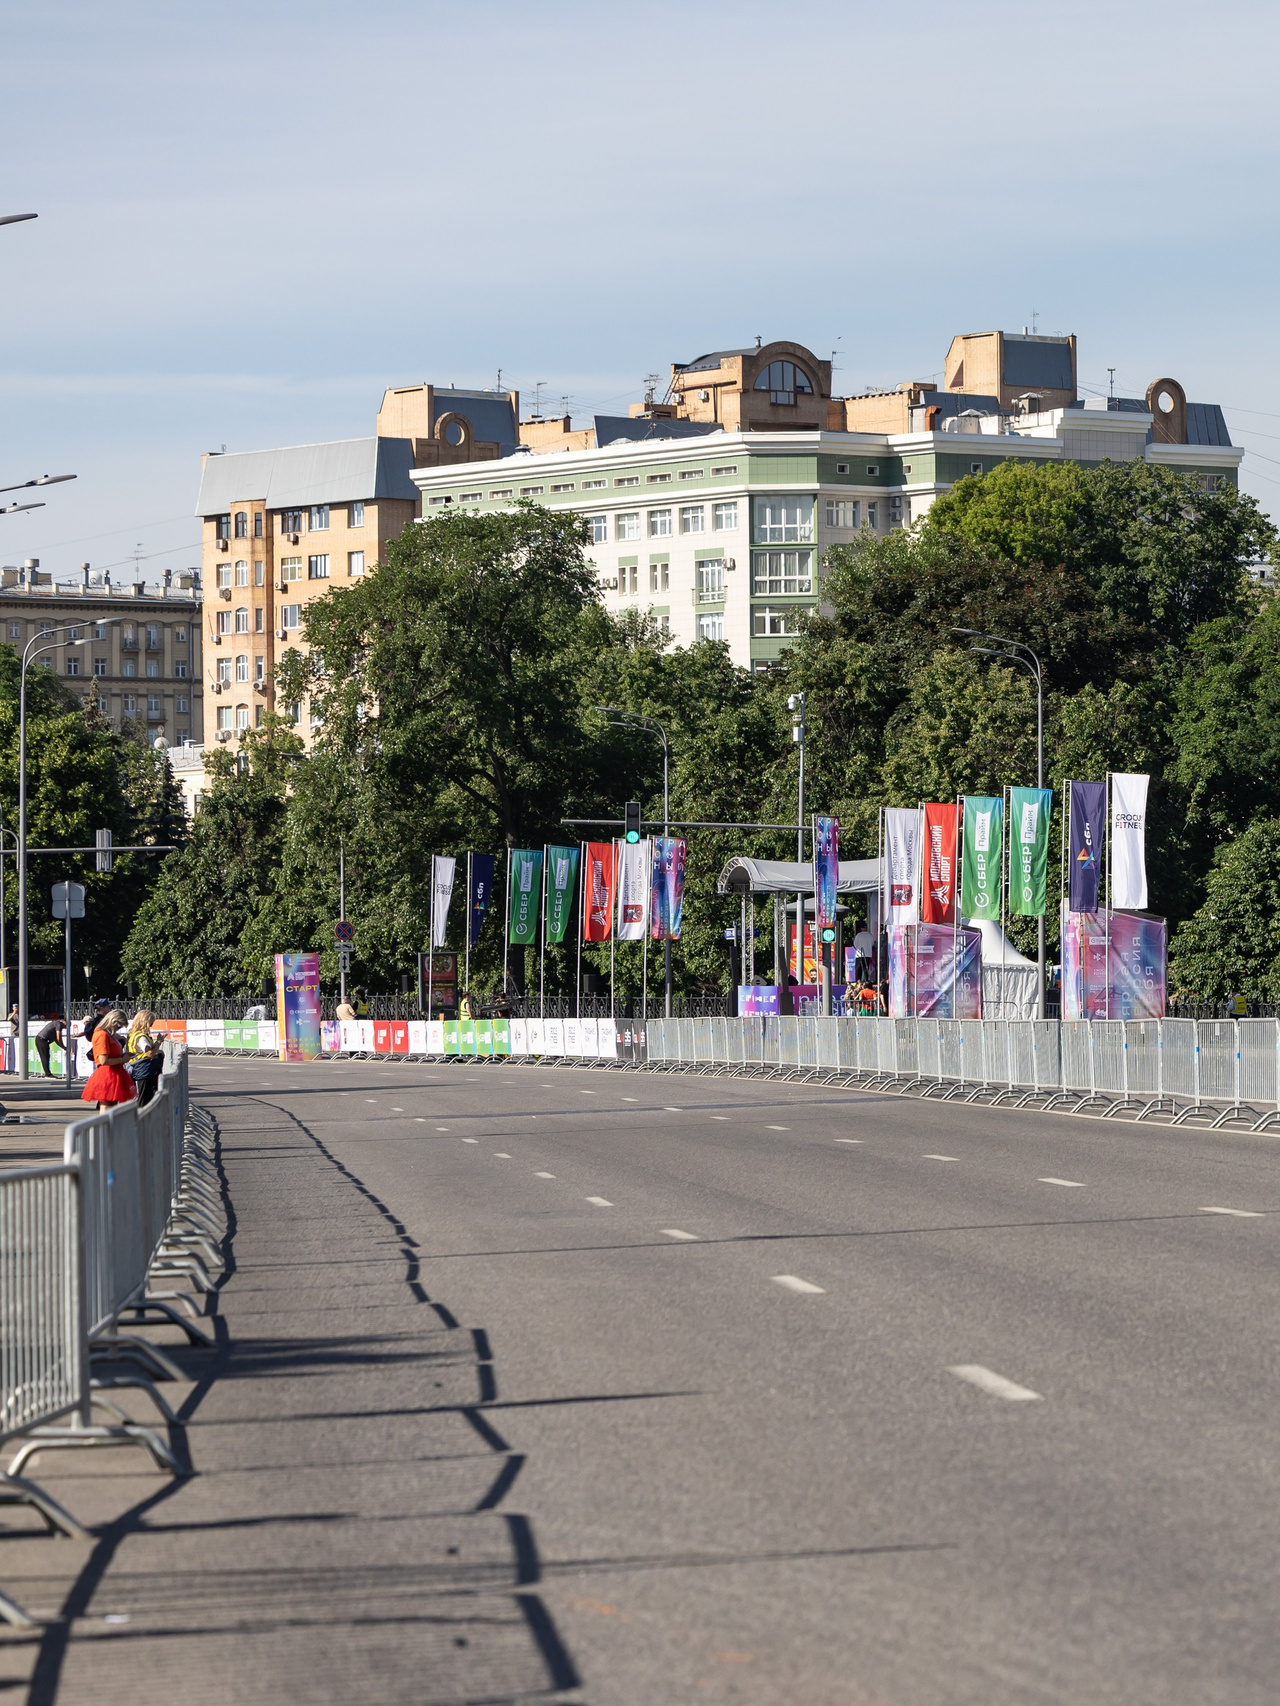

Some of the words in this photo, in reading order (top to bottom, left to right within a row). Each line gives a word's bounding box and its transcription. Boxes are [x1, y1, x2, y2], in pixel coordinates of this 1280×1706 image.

[978, 818, 986, 847] Прайм
[1024, 810, 1033, 839] Прайм
[1084, 822, 1092, 846] сбп
[891, 836, 899, 880] Департамент
[930, 825, 942, 881] МОСКОВСКИЙ
[1022, 846, 1032, 883] СБЕР
[522, 865, 530, 889] Прайм
[592, 860, 603, 906] МОСКОВСКИЙ
[941, 855, 950, 882] СПОРТ
[977, 854, 987, 889] СБЕР
[520, 893, 529, 920] СБЕР
[553, 891, 562, 919] СБЕР
[600, 886, 610, 907] СПОРТ
[286, 985, 317, 993] СТАРТ
[1121, 952, 1132, 1016] яркая
